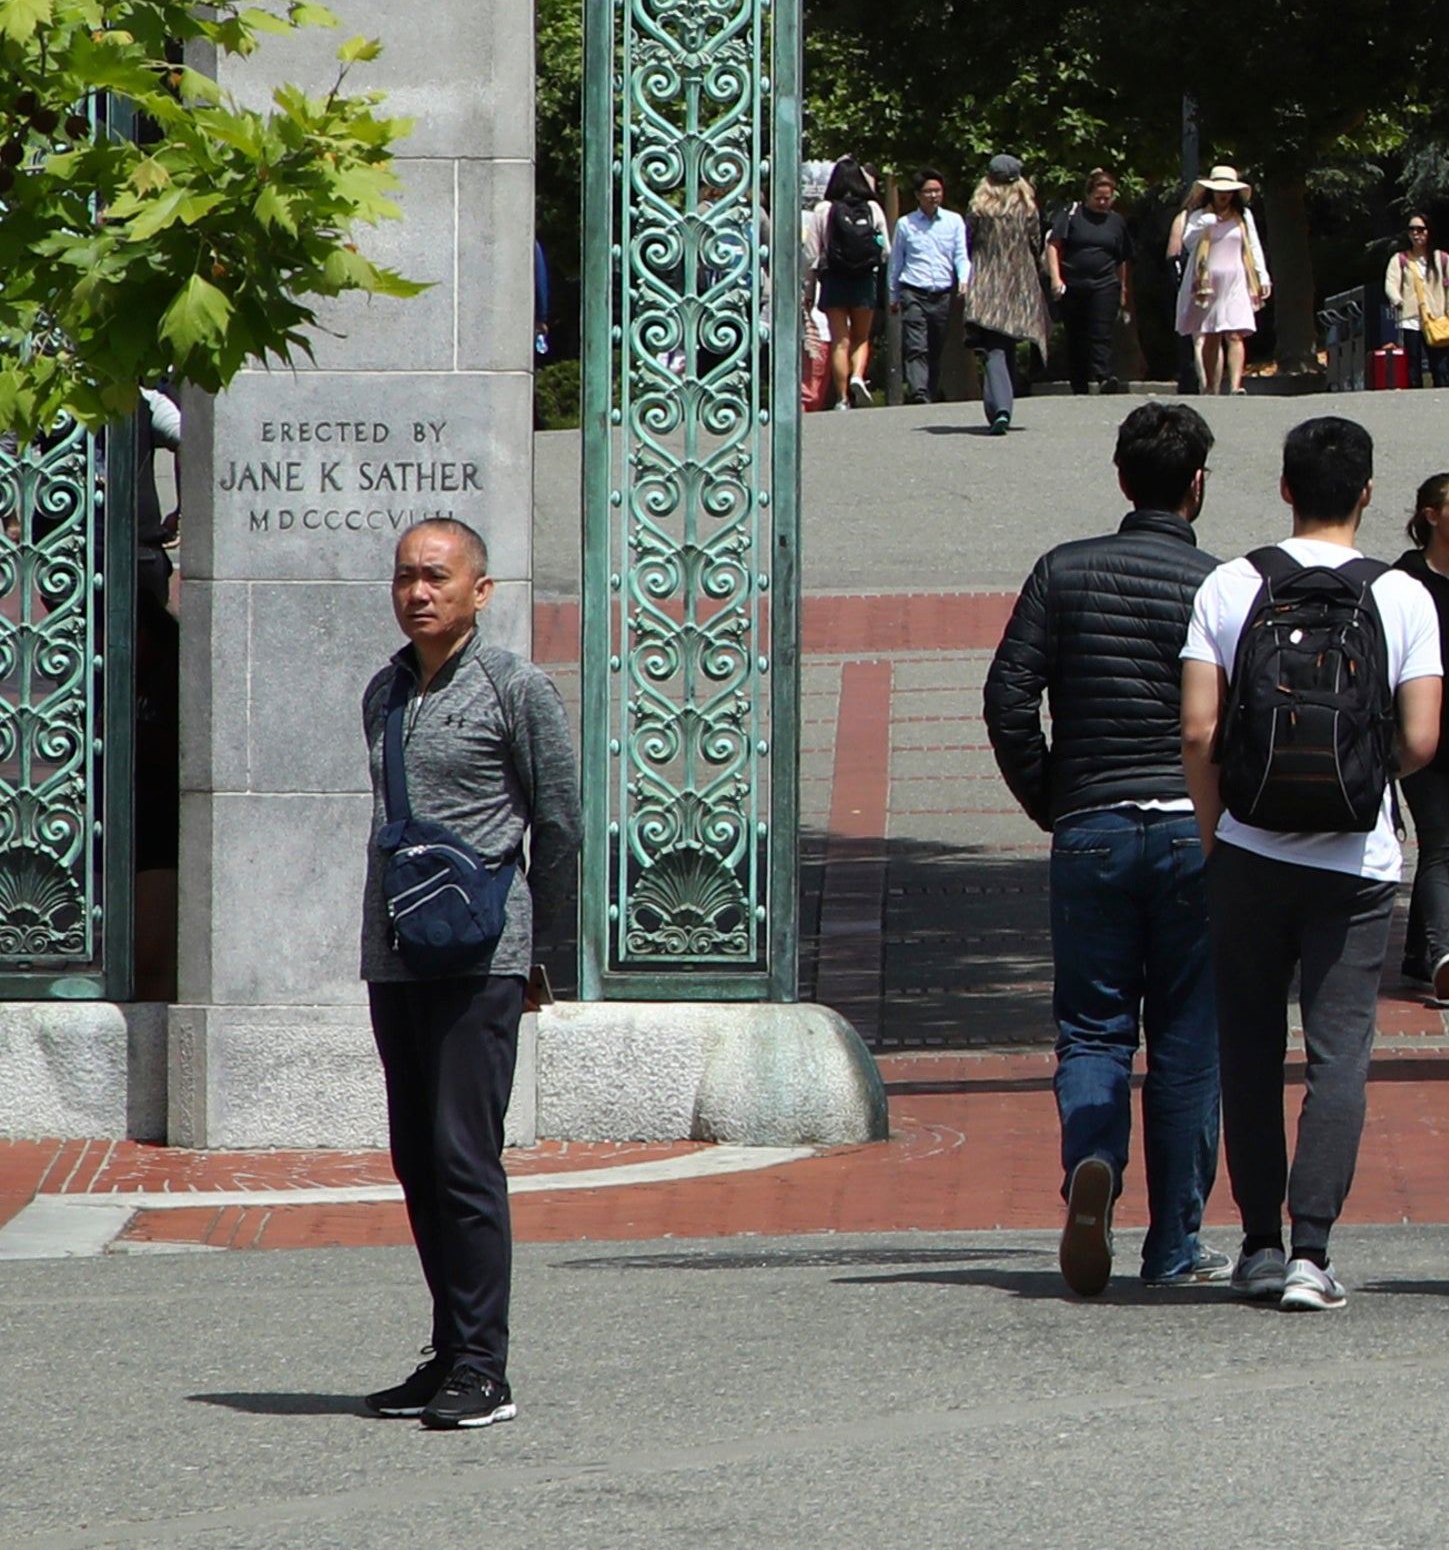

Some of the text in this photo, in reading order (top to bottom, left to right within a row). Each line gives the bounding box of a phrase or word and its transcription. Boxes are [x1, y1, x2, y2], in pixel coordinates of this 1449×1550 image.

[262, 421, 448, 443] ERECTED BY
[219, 461, 484, 492] JANE K SATHER
